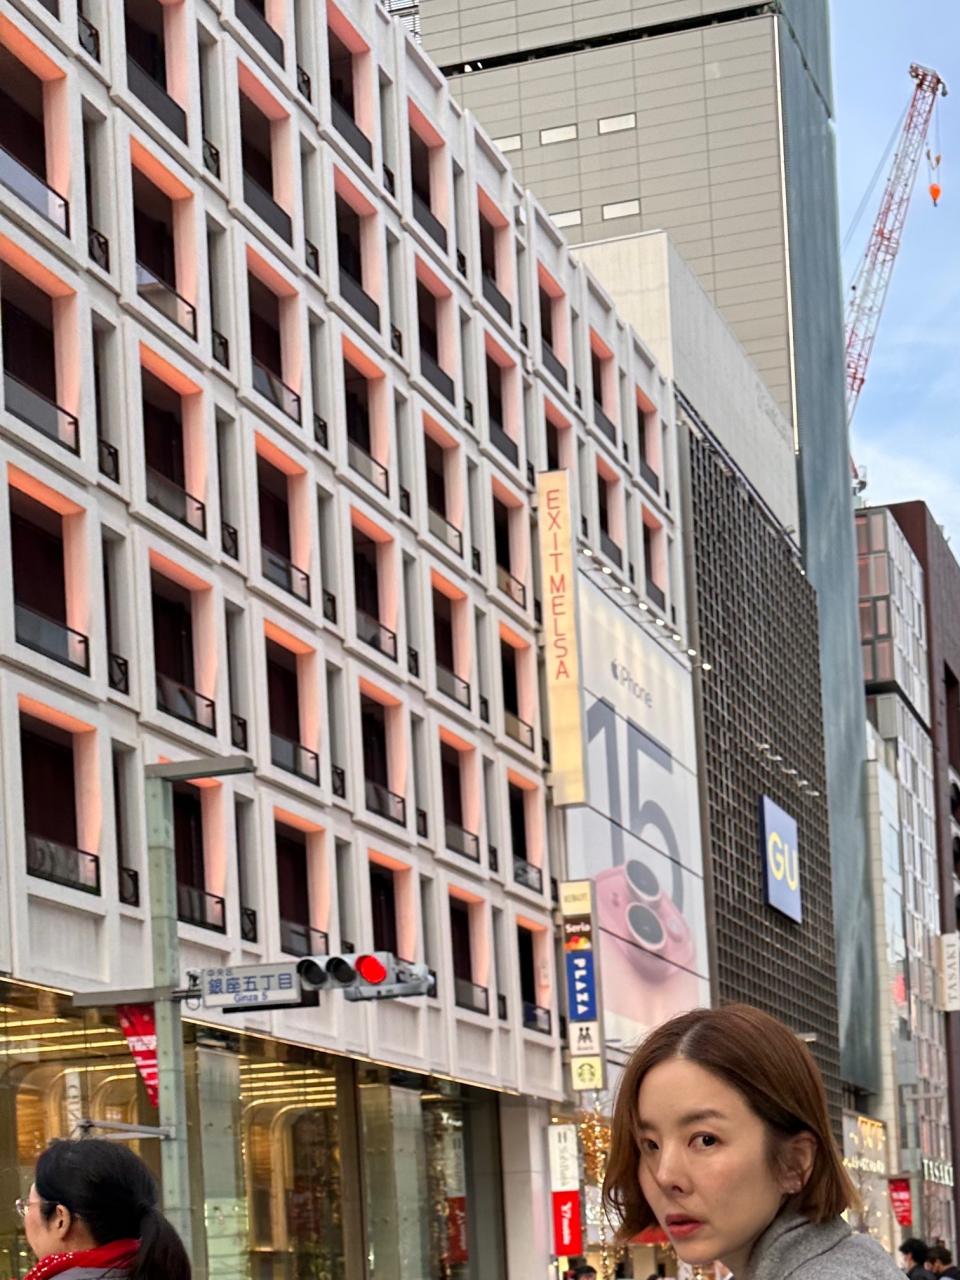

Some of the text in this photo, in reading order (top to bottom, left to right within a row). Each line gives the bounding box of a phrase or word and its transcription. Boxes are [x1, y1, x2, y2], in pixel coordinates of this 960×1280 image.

[586, 696, 684, 915] 15
[768, 831, 799, 891] GU
[208, 973, 293, 995] 銀座五丁目
[234, 991, 268, 1003] Ginza 5
[574, 958, 590, 1015] PLAZA
[946, 943, 958, 1003] TASAKI
[923, 1159, 955, 1188] TASAKI
